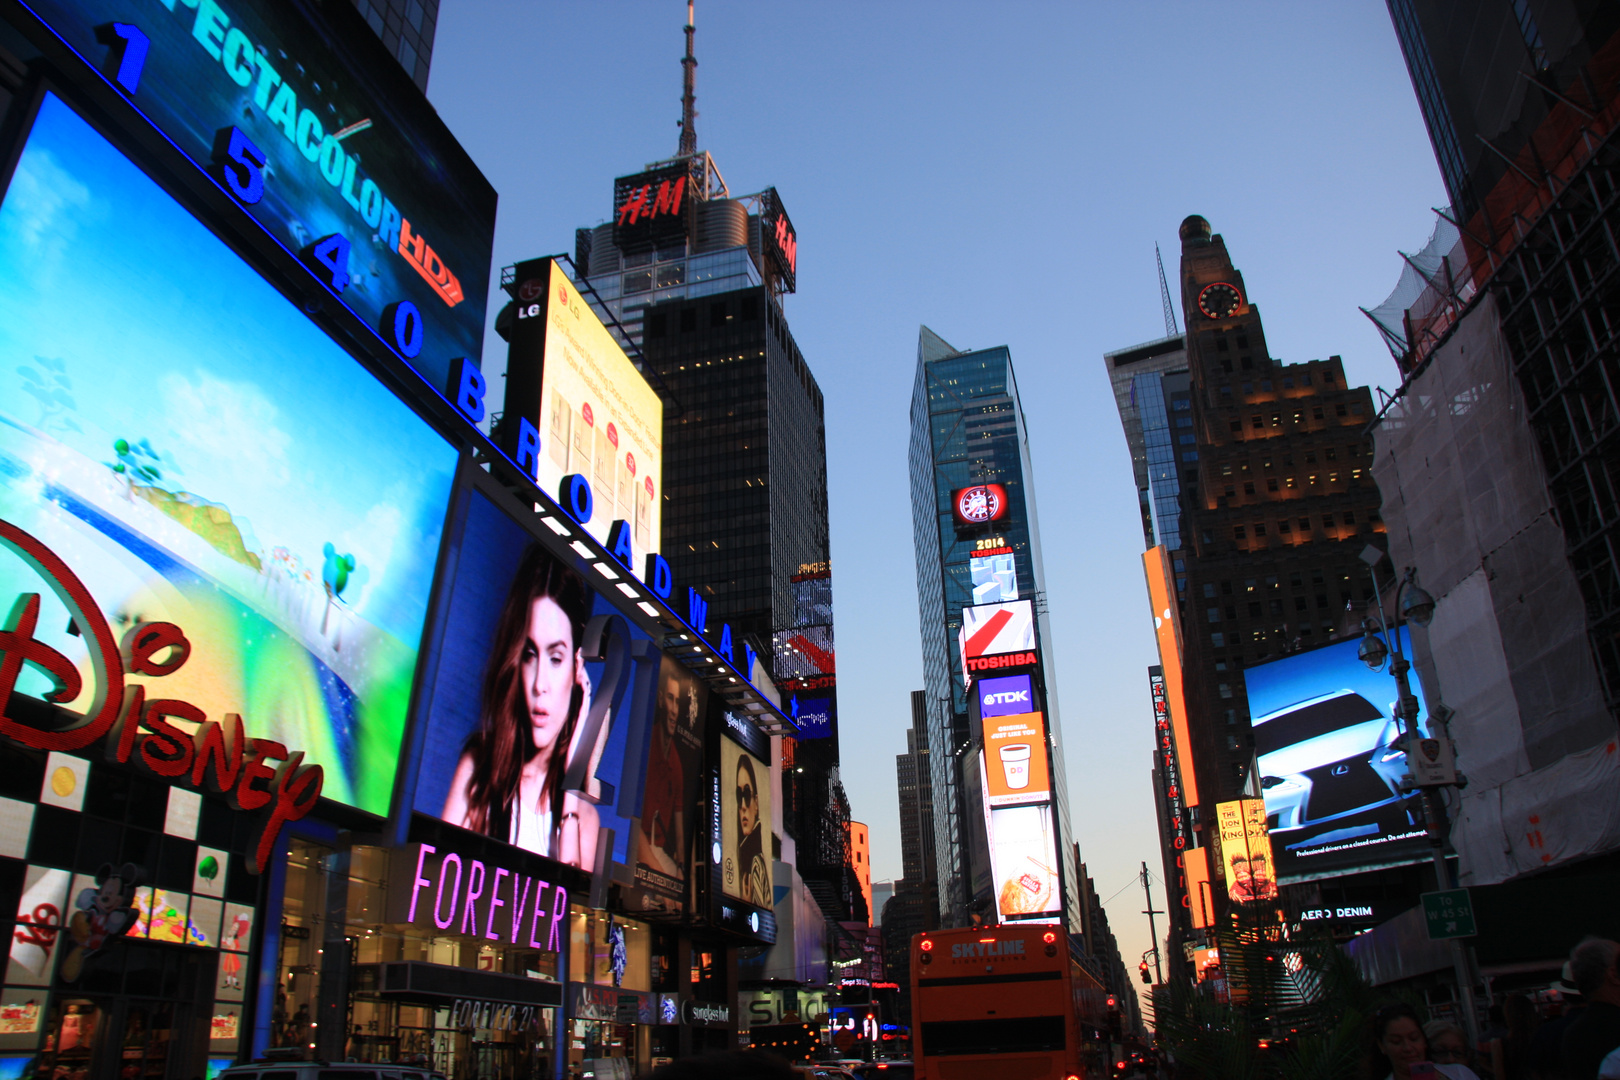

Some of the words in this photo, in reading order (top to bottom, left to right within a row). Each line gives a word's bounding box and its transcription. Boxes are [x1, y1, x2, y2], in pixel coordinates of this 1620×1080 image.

[160, 0, 401, 254] ECTACOLOR
[618, 176, 686, 227] H&M
[775, 213, 797, 274] H&M
[518, 303, 540, 319] LG
[569, 298, 580, 321] LG
[113, 22, 423, 358] 1540
[456, 357, 755, 681] BROADWAY
[565, 327, 585, 357] Award
[586, 352, 608, 388] Winning
[970, 546, 1013, 558] TOSHIBA
[977, 537, 1005, 550] 2014
[967, 652, 1037, 671] TOSHIBA
[994, 690, 1029, 704] TDK
[998, 723, 1028, 732] ORIGINAL
[1154, 684, 1172, 767] ERNST
[1168, 786, 1178, 798] &
[1010, 766, 1023, 775] DD
[1222, 811, 1236, 819] THE
[1296, 846, 1325, 857] Professional
[1324, 843, 1343, 853] drivers
[1353, 838, 1369, 848] closed
[1369, 837, 1388, 845] course.
[1406, 829, 1428, 838] attempt.
[407, 842, 568, 952] FOREVER
[1336, 906, 1373, 918] DENIM
[1427, 910, 1438, 920] W
[1442, 908, 1455, 919] 45
[951, 939, 1026, 958] SKYLINE
[450, 999, 517, 1031] FOREVER
[518, 1006, 535, 1032] 21
[692, 1004, 718, 1025] sunglass
[718, 1005, 729, 1022] hut
